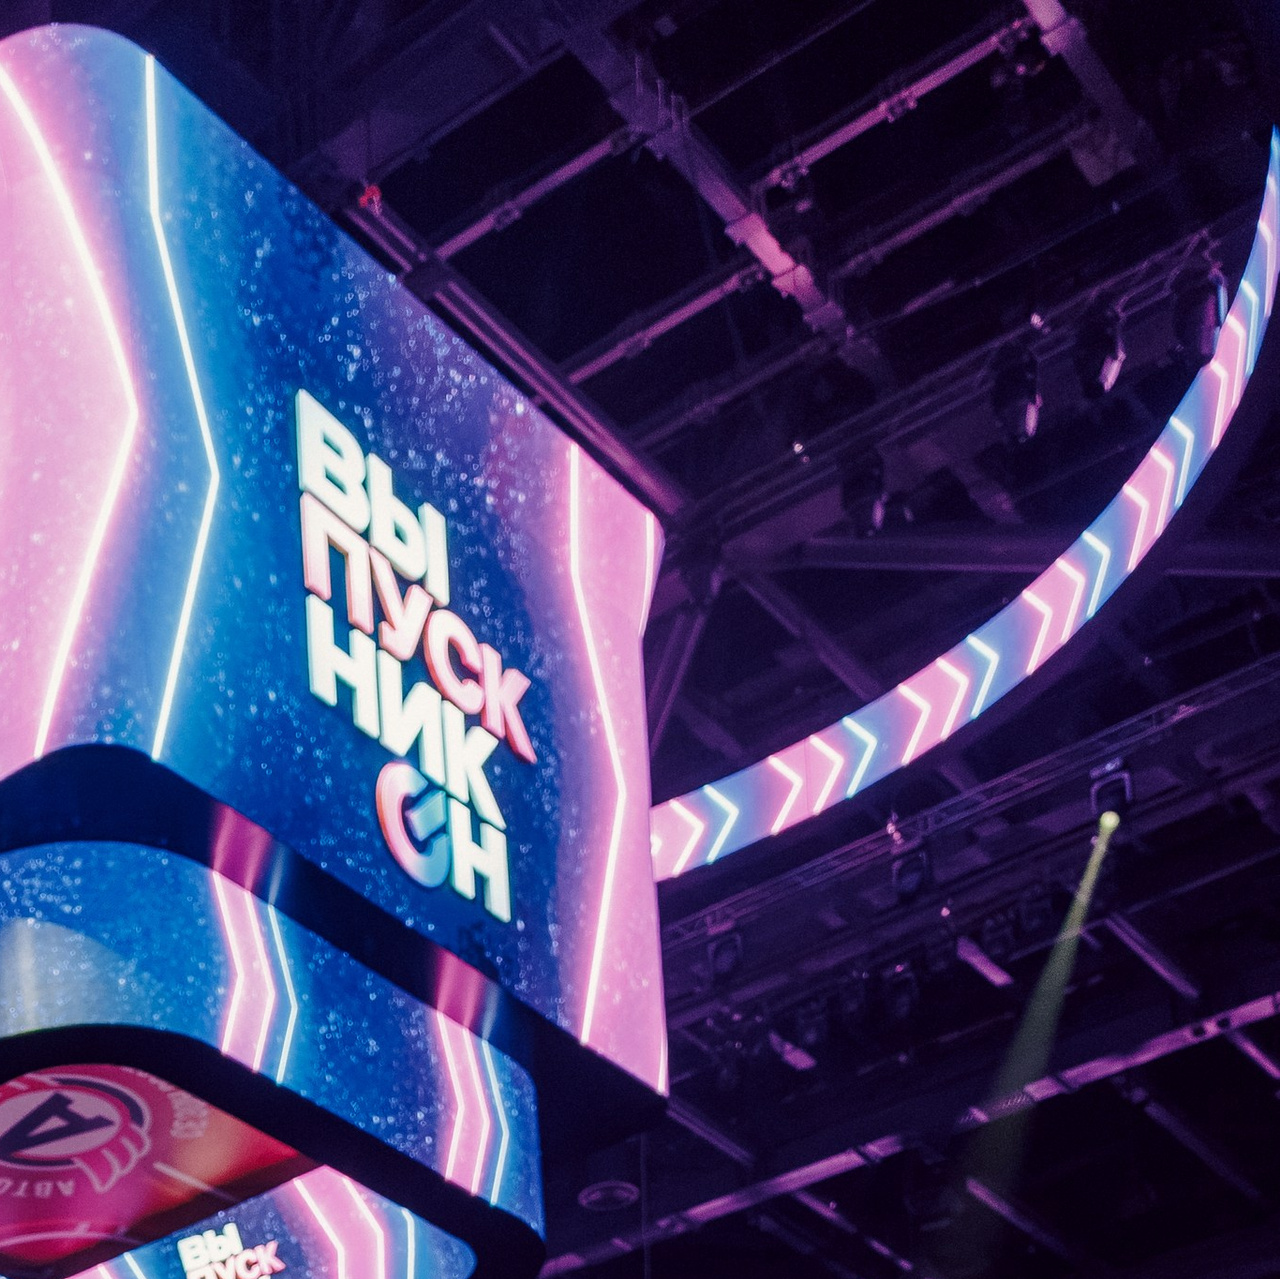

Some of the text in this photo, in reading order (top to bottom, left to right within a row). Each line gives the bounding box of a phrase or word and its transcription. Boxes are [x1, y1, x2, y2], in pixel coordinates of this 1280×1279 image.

[295, 388, 450, 608] ВЫ
[300, 491, 537, 764] ПУСК
[305, 593, 507, 830] НИК
[177, 1222, 243, 1273] ВЫ
